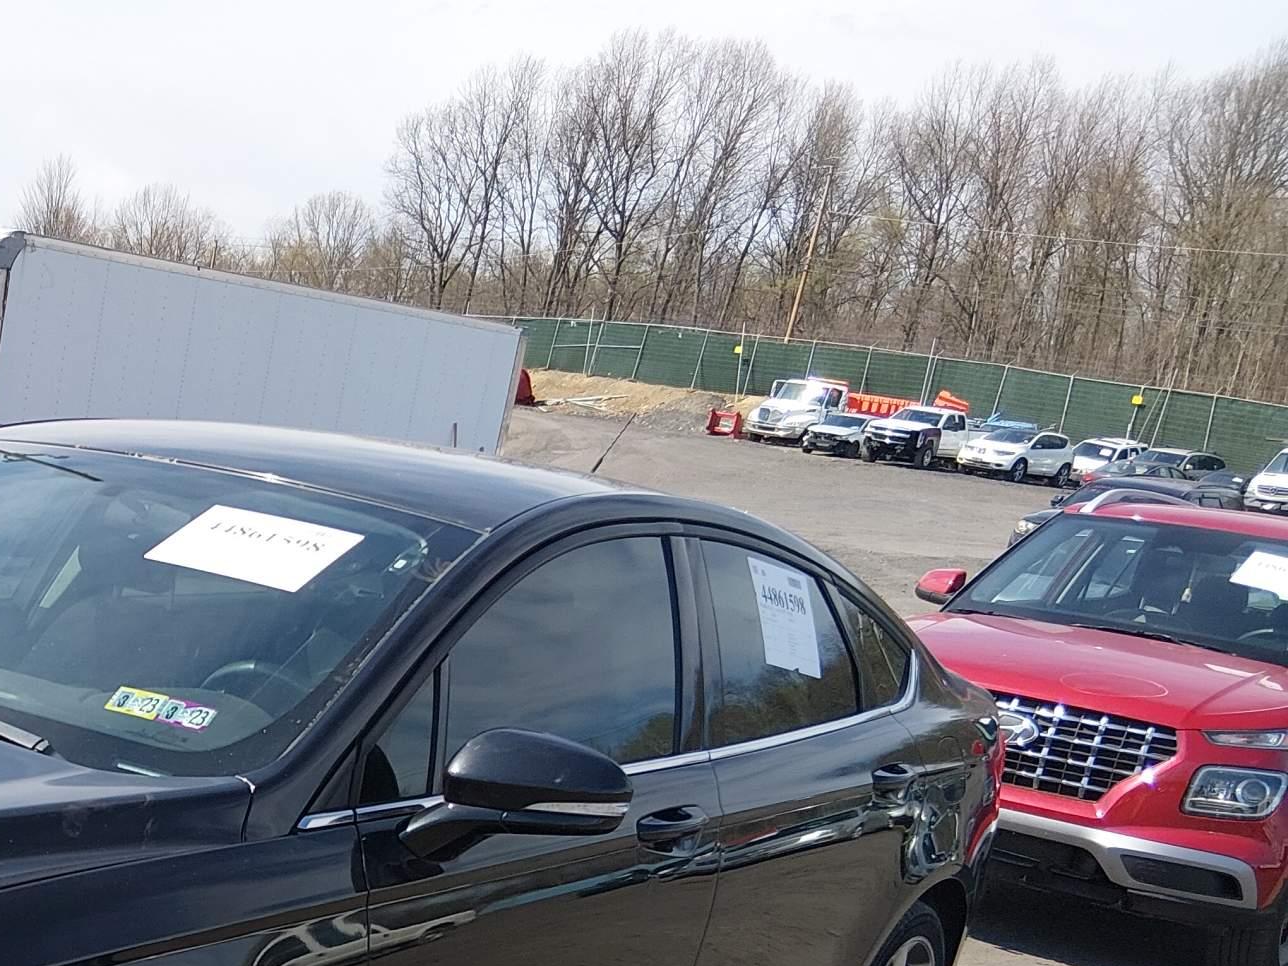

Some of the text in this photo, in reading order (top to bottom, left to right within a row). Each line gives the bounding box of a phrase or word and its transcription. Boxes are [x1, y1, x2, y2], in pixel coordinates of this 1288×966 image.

[761, 584, 807, 616] 44861598
[116, 694, 160, 714] 3 23
[165, 705, 210, 726] 3 23
